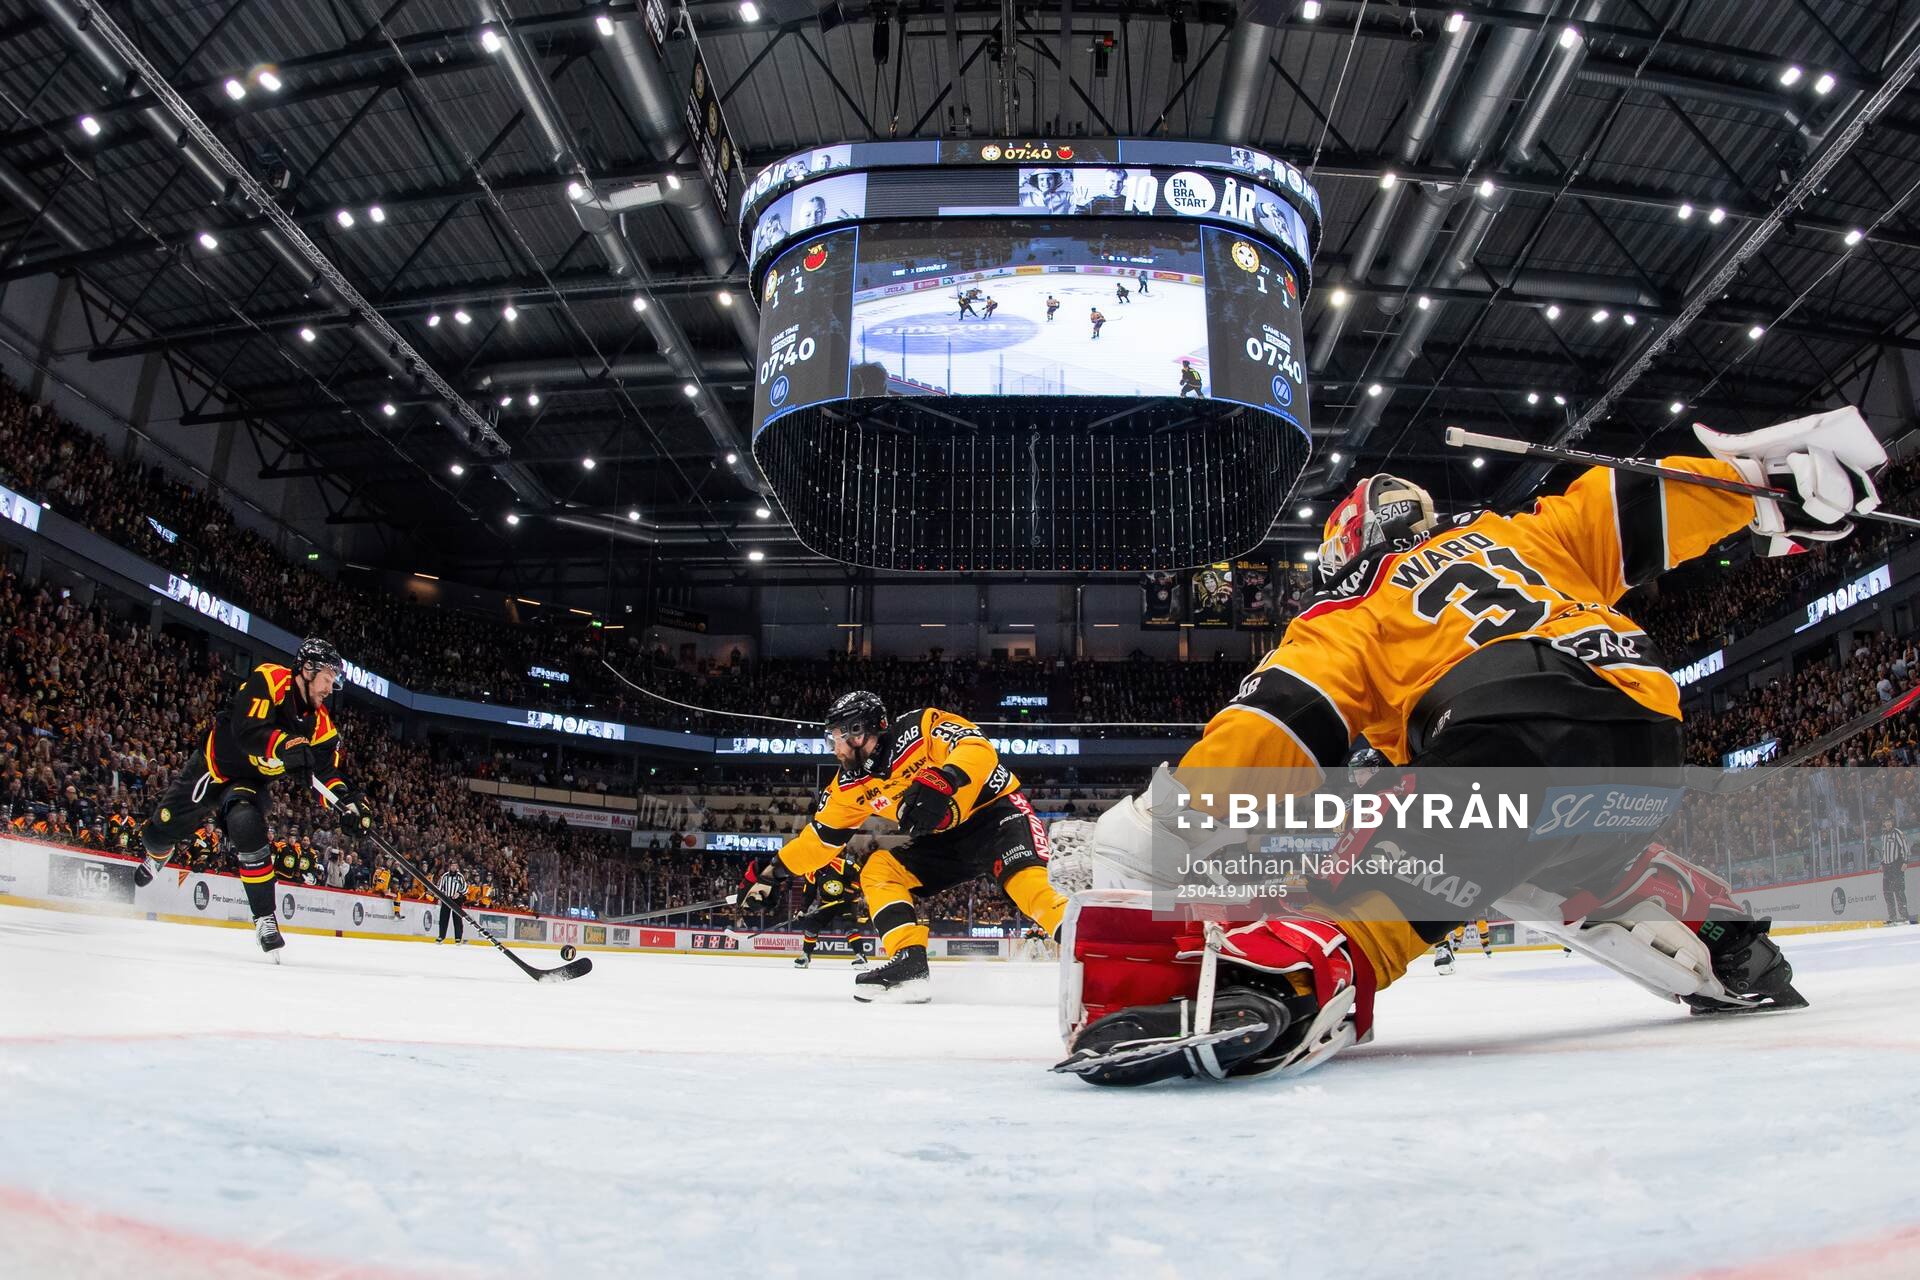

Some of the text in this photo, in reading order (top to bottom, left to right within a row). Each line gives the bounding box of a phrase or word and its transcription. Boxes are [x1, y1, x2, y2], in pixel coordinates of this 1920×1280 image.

[1004, 148, 1052, 160] 07:40
[1173, 178, 1187, 187] EN
[1173, 188, 1195, 198] BRA
[1124, 175, 1257, 224] 10 ÅR
[1174, 198, 1208, 209] START
[794, 277, 805, 295] 1
[1257, 275, 1290, 310] 1 1
[772, 291, 780, 309] 1
[784, 323, 800, 338] TIME
[1262, 324, 1280, 339] GAME
[760, 337, 816, 385] 07:40
[1246, 337, 1302, 385] 07:40
[1375, 501, 1410, 525] SSAB
[1390, 532, 1496, 592] WARD
[1413, 546, 1577, 651] 31
[247, 698, 270, 719] 70
[896, 725, 919, 753] SSAB
[1602, 791, 1669, 812] Student
[1593, 810, 1666, 829] Consulti
[77, 868, 110, 893] NKB
